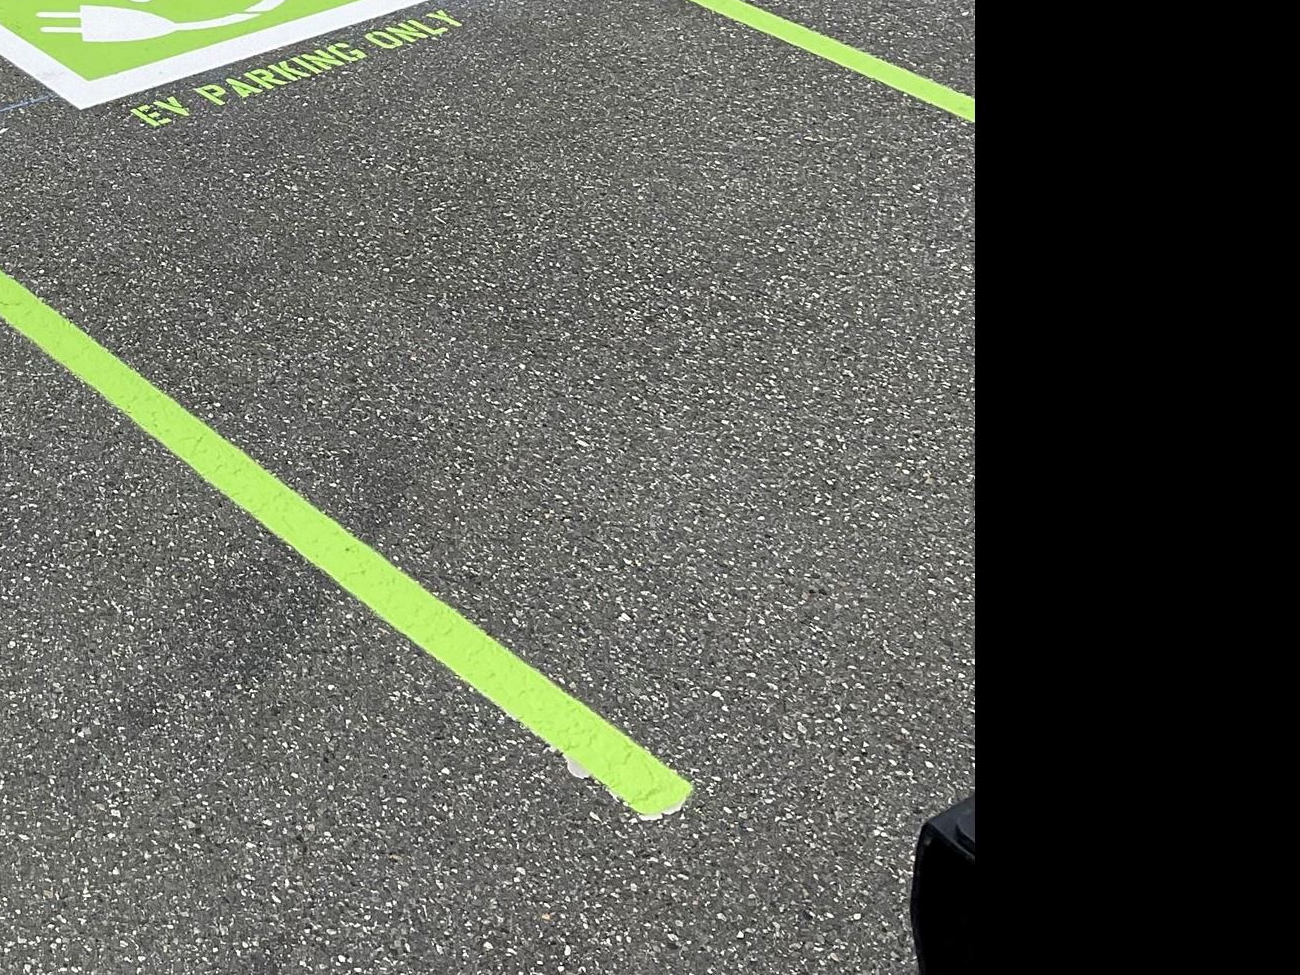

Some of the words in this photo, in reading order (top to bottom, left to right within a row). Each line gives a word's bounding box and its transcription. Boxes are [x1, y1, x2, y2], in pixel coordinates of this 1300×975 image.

[130, 96, 190, 127] EV
[194, 42, 367, 106] PARKING
[365, 9, 463, 50] ONLY
